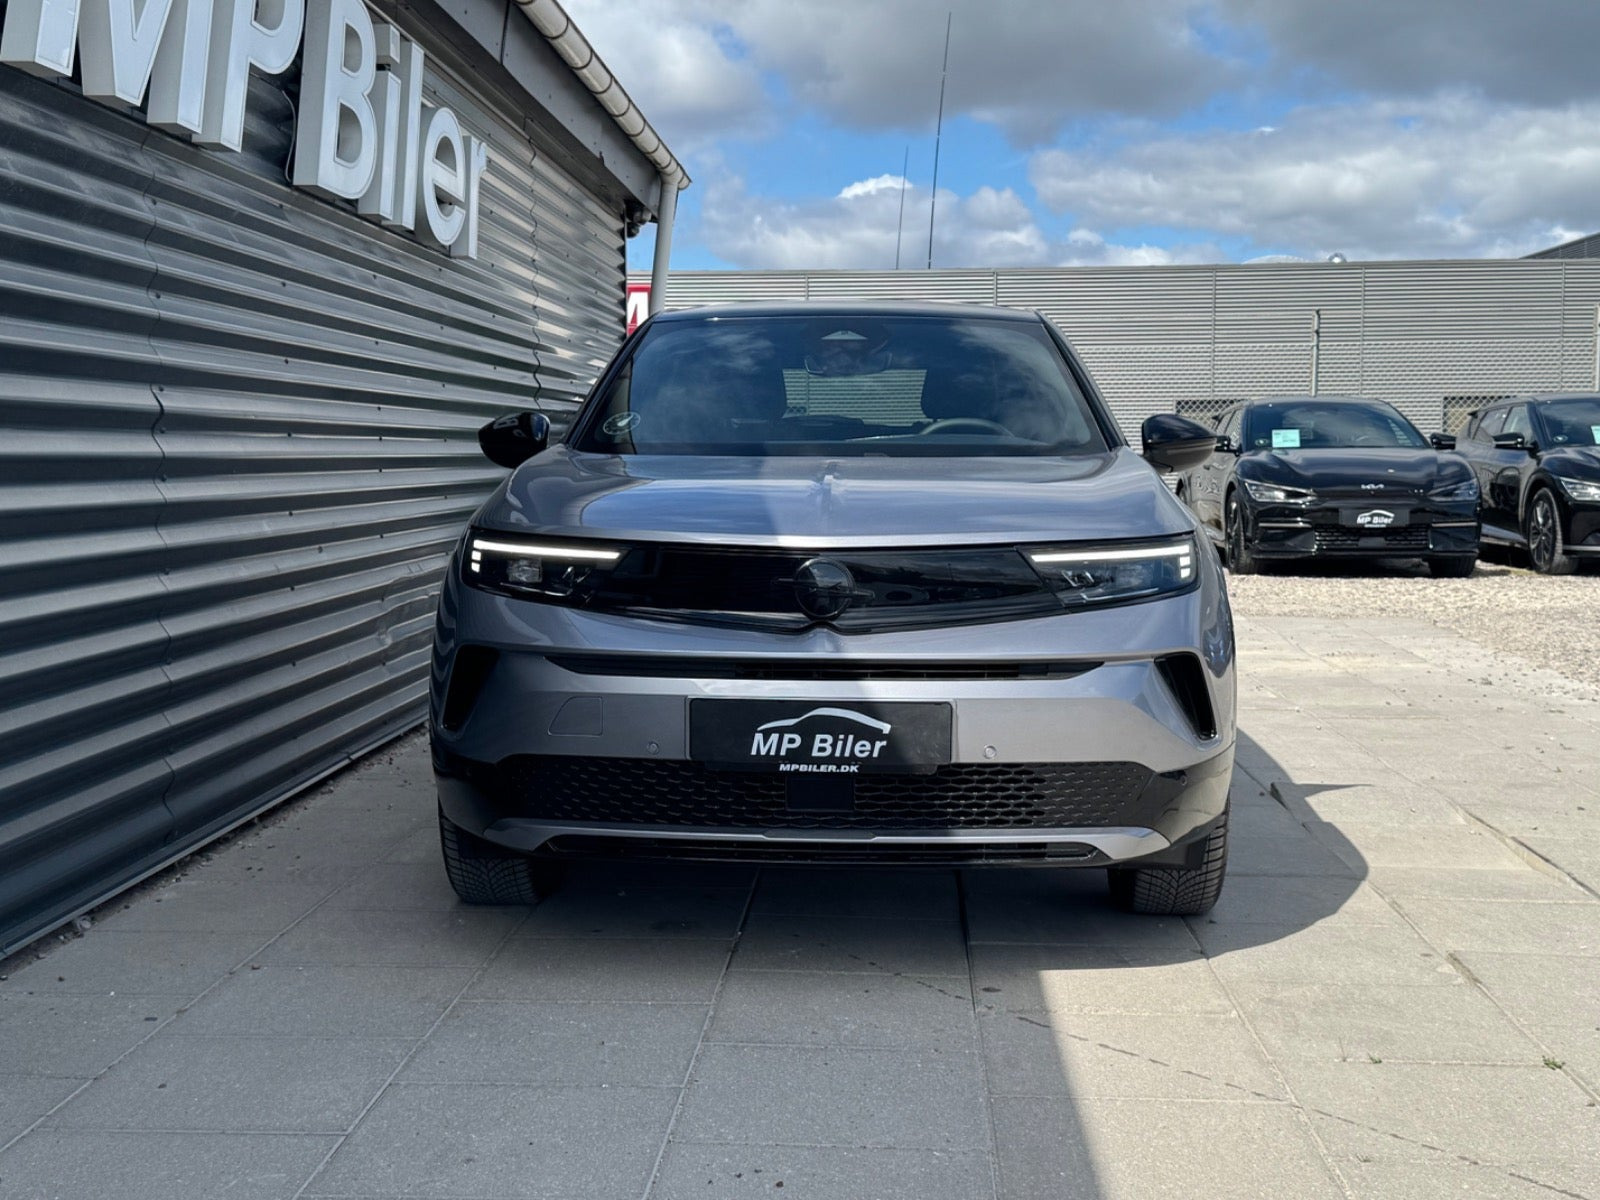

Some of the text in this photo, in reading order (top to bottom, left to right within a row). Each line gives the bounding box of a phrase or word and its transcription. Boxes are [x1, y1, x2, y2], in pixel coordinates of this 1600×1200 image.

[296, 0, 488, 259] Biler
[751, 733, 887, 758] MP Biler
[779, 763, 858, 772] MPBILER.DK
